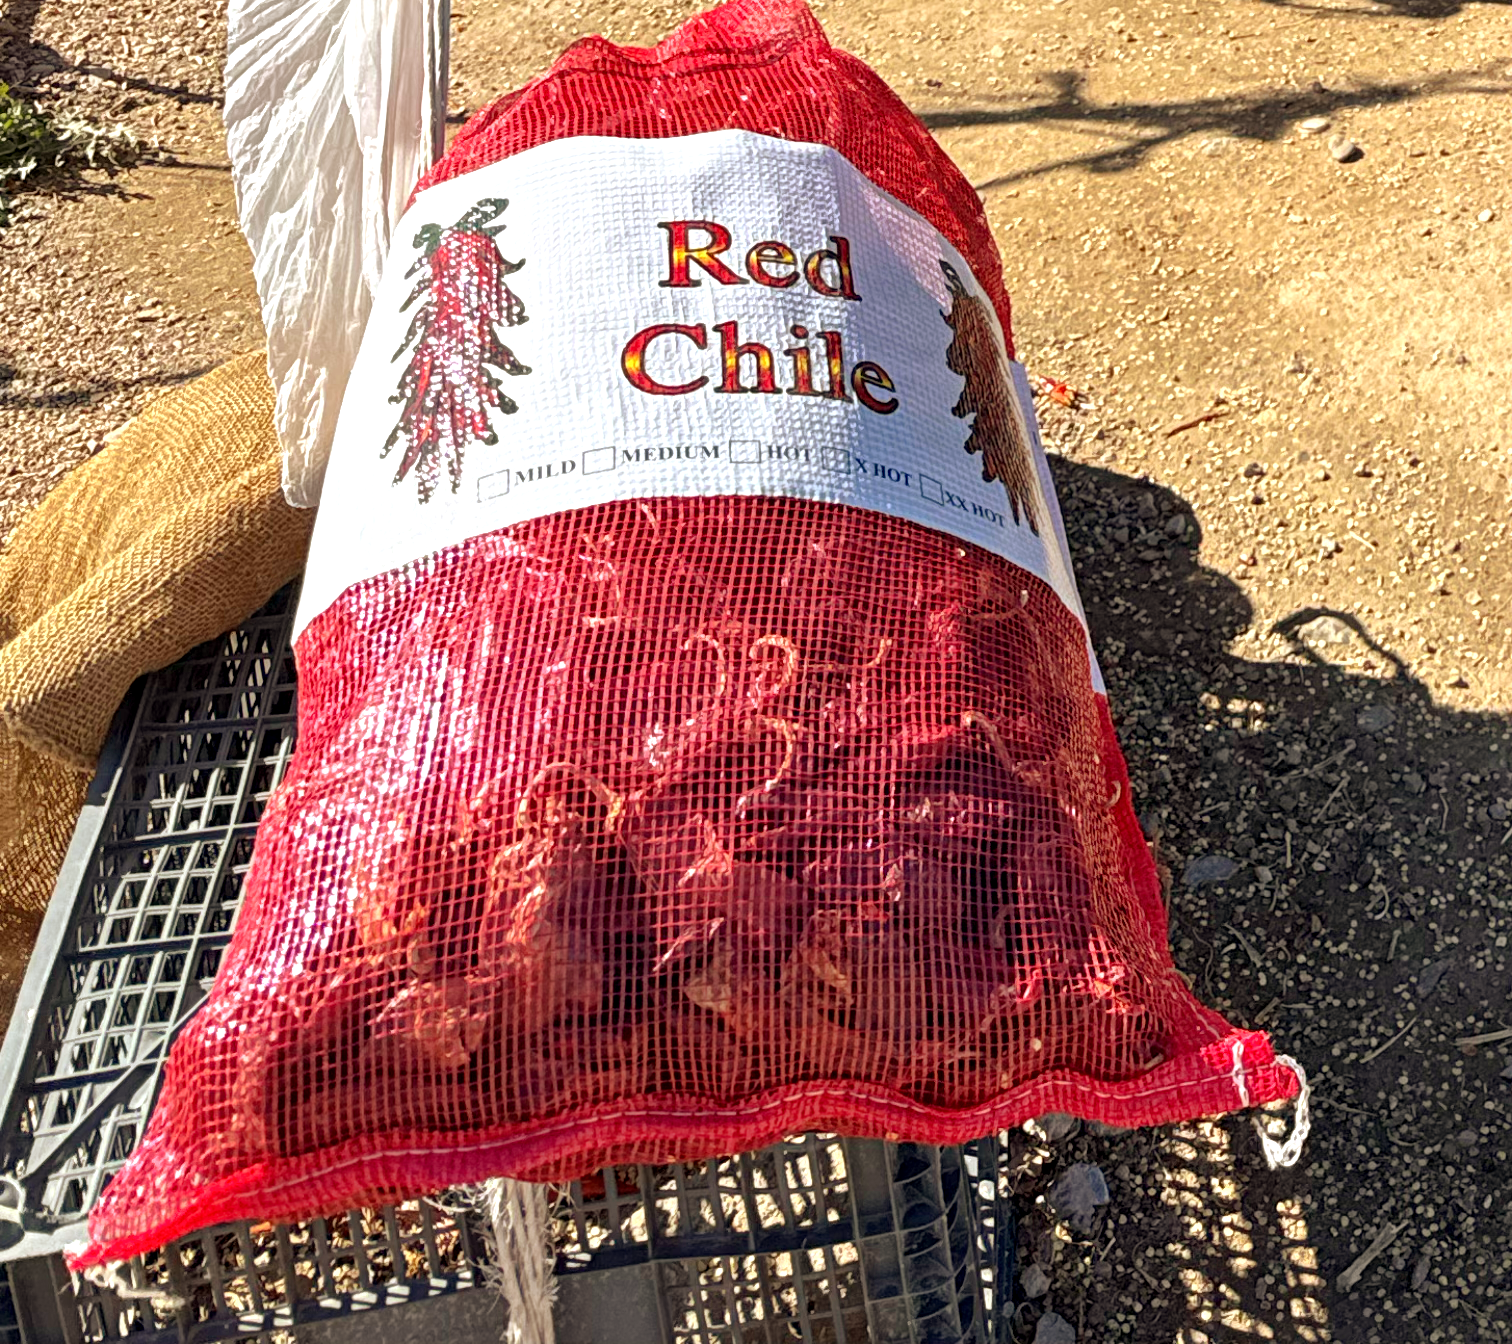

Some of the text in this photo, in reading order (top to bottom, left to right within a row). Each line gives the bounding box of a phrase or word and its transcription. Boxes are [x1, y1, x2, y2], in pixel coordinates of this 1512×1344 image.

[658, 219, 862, 302] Red
[620, 320, 899, 415] Chile
[514, 444, 1007, 529] MILD MEDIUM HOT X HOT XX HOT
